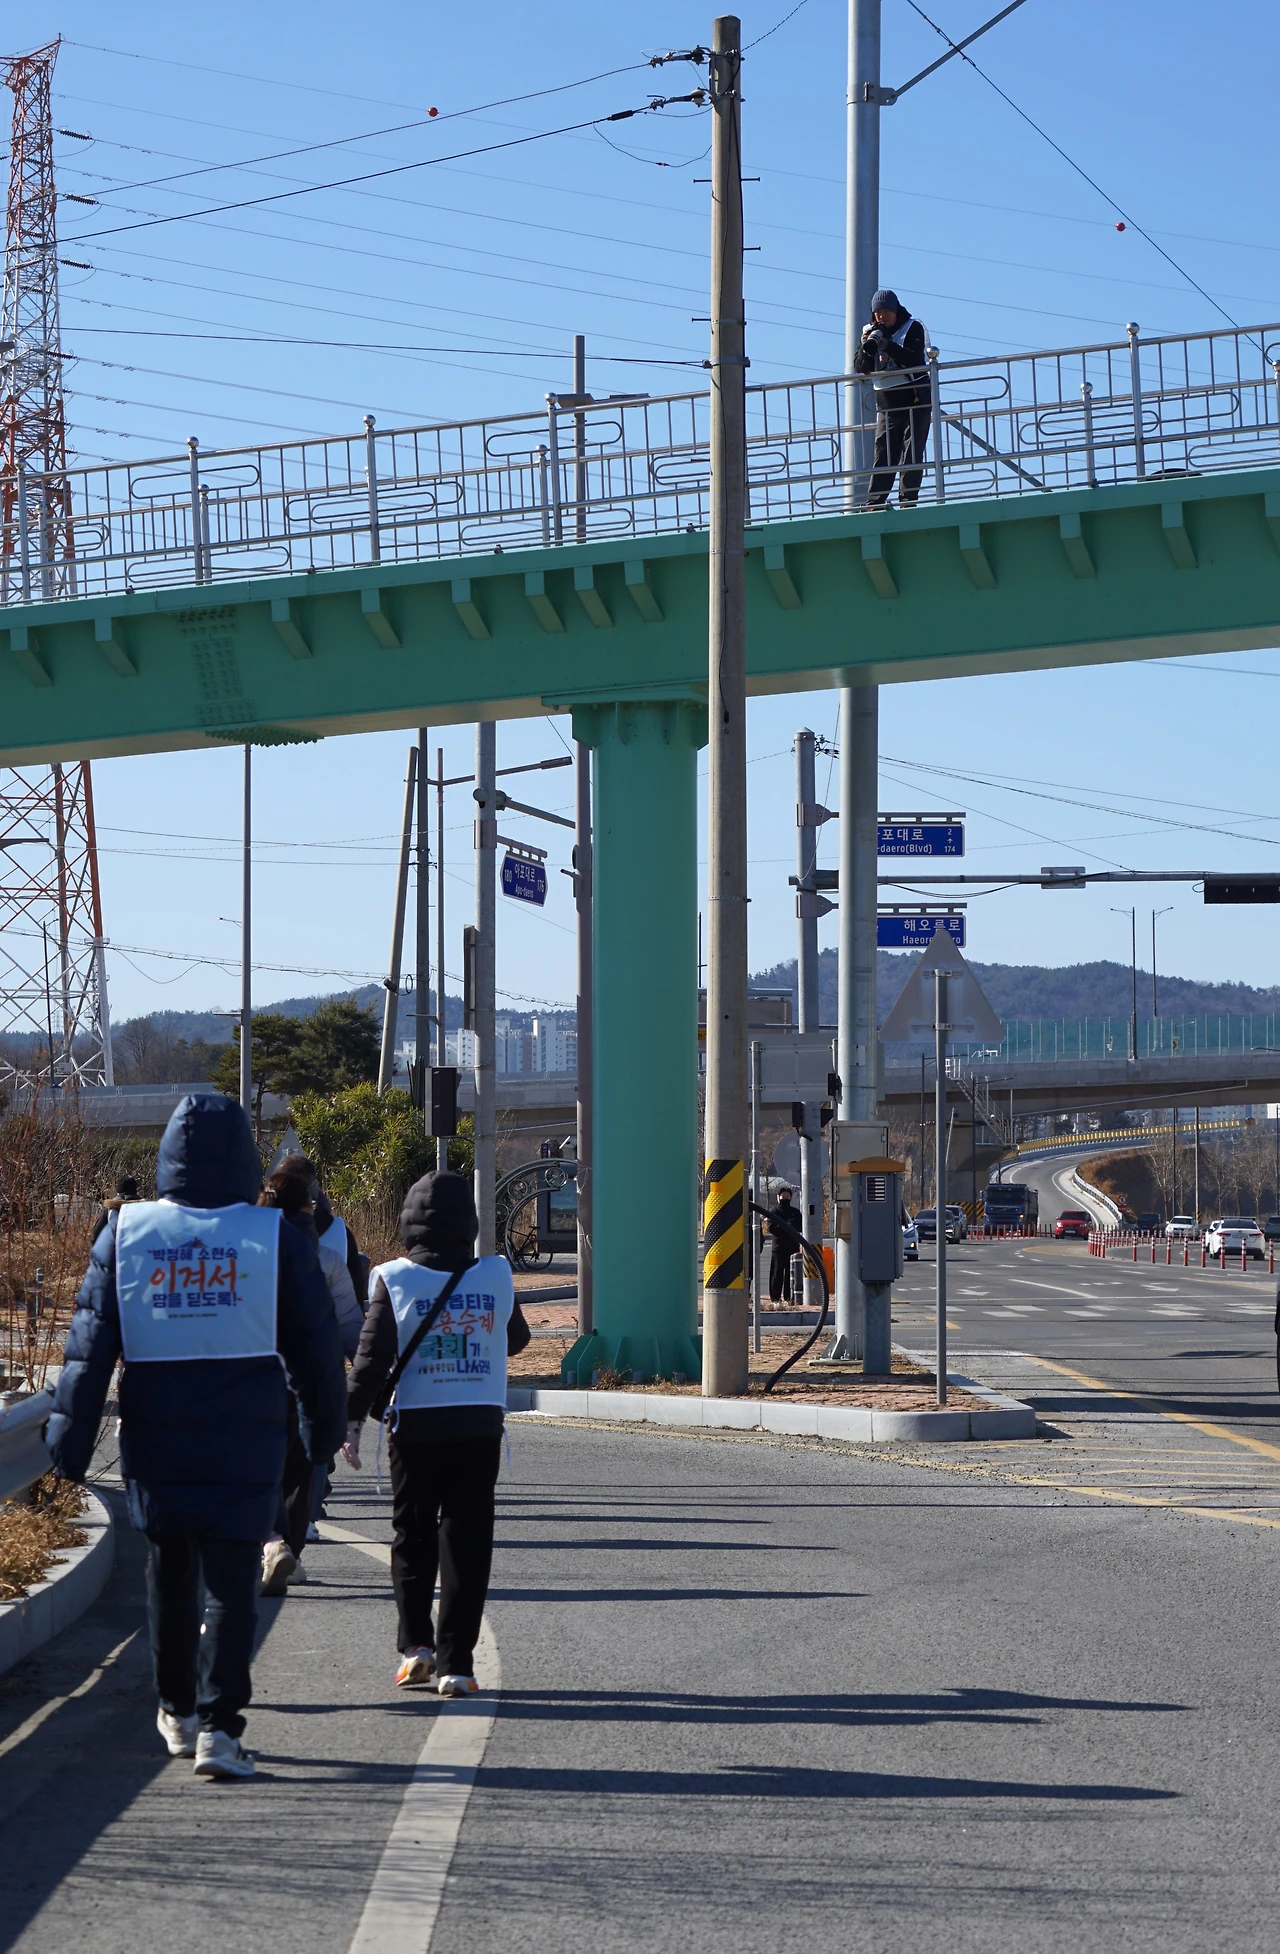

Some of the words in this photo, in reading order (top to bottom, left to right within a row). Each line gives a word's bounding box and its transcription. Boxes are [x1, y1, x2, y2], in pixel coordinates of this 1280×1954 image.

[878, 829, 924, 841] 포대로
[504, 869, 512, 882] 180
[515, 863, 535, 882] 아포대로
[152, 1248, 193, 1262] 박정혜
[197, 1247, 238, 1261] 소현숙
[151, 1258, 236, 1293] 이겨서
[153, 1292, 182, 1308] 땅을
[415, 1293, 496, 1317] 한옵티칼
[420, 1308, 496, 1336] 용승계
[470, 1342, 481, 1357] 가
